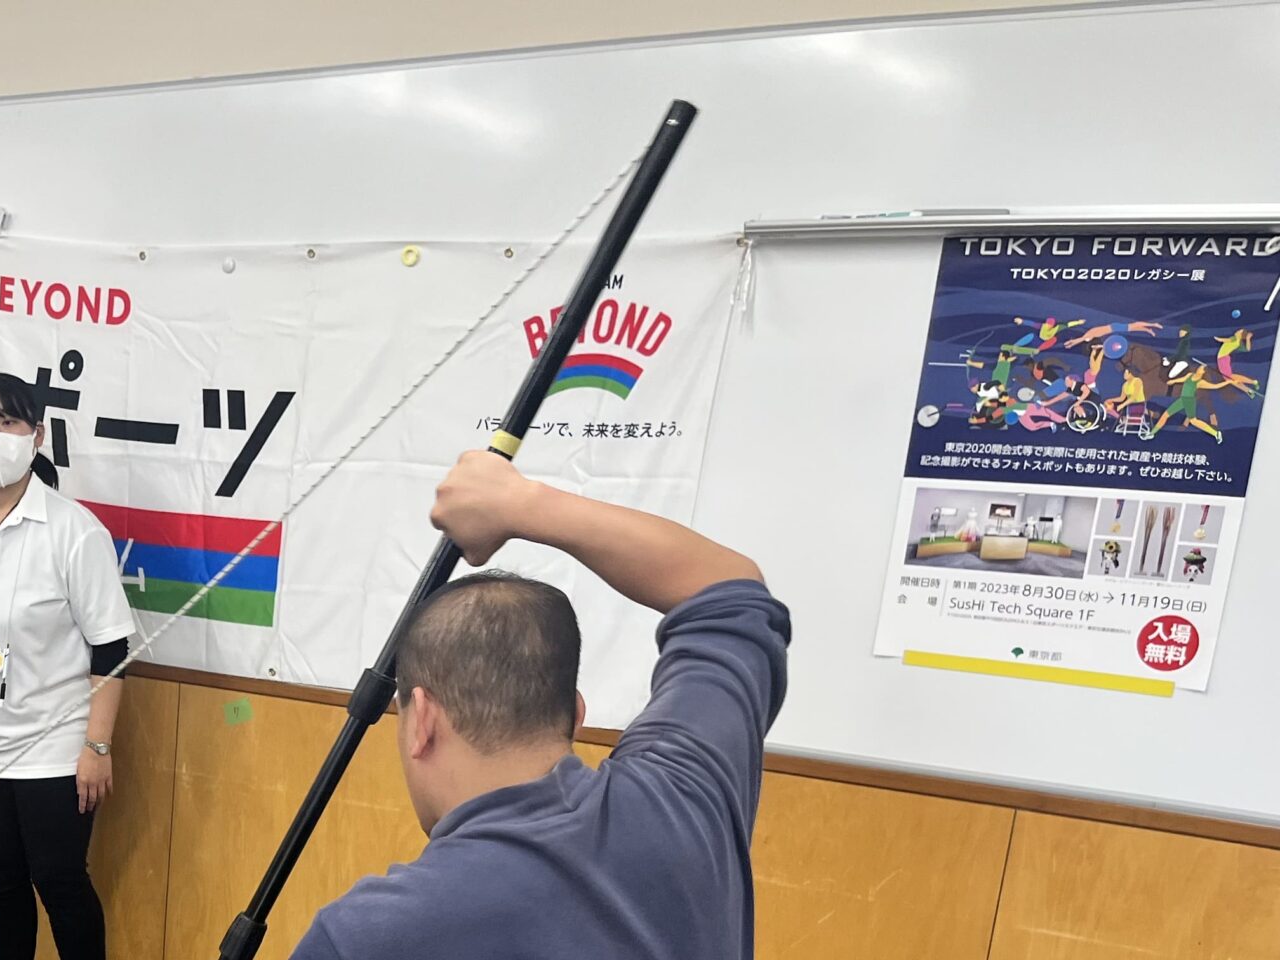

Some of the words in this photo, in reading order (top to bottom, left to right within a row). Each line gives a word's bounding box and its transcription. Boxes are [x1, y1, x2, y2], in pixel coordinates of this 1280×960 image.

[959, 237, 1075, 257] TOKYO
[1091, 236, 1277, 257] FORWARD
[1010, 267, 1207, 283] TOKYO2020レガシー展
[523, 298, 673, 359] BOND
[476, 417, 683, 439] パラーツで、未来を変えよう。
[949, 597, 985, 612] SusHi
[990, 600, 1021, 615] Tech
[1025, 604, 1074, 620] Square
[1078, 609, 1096, 622] 1F
[1148, 621, 1192, 645] 入場
[1142, 638, 1187, 667] 無料
